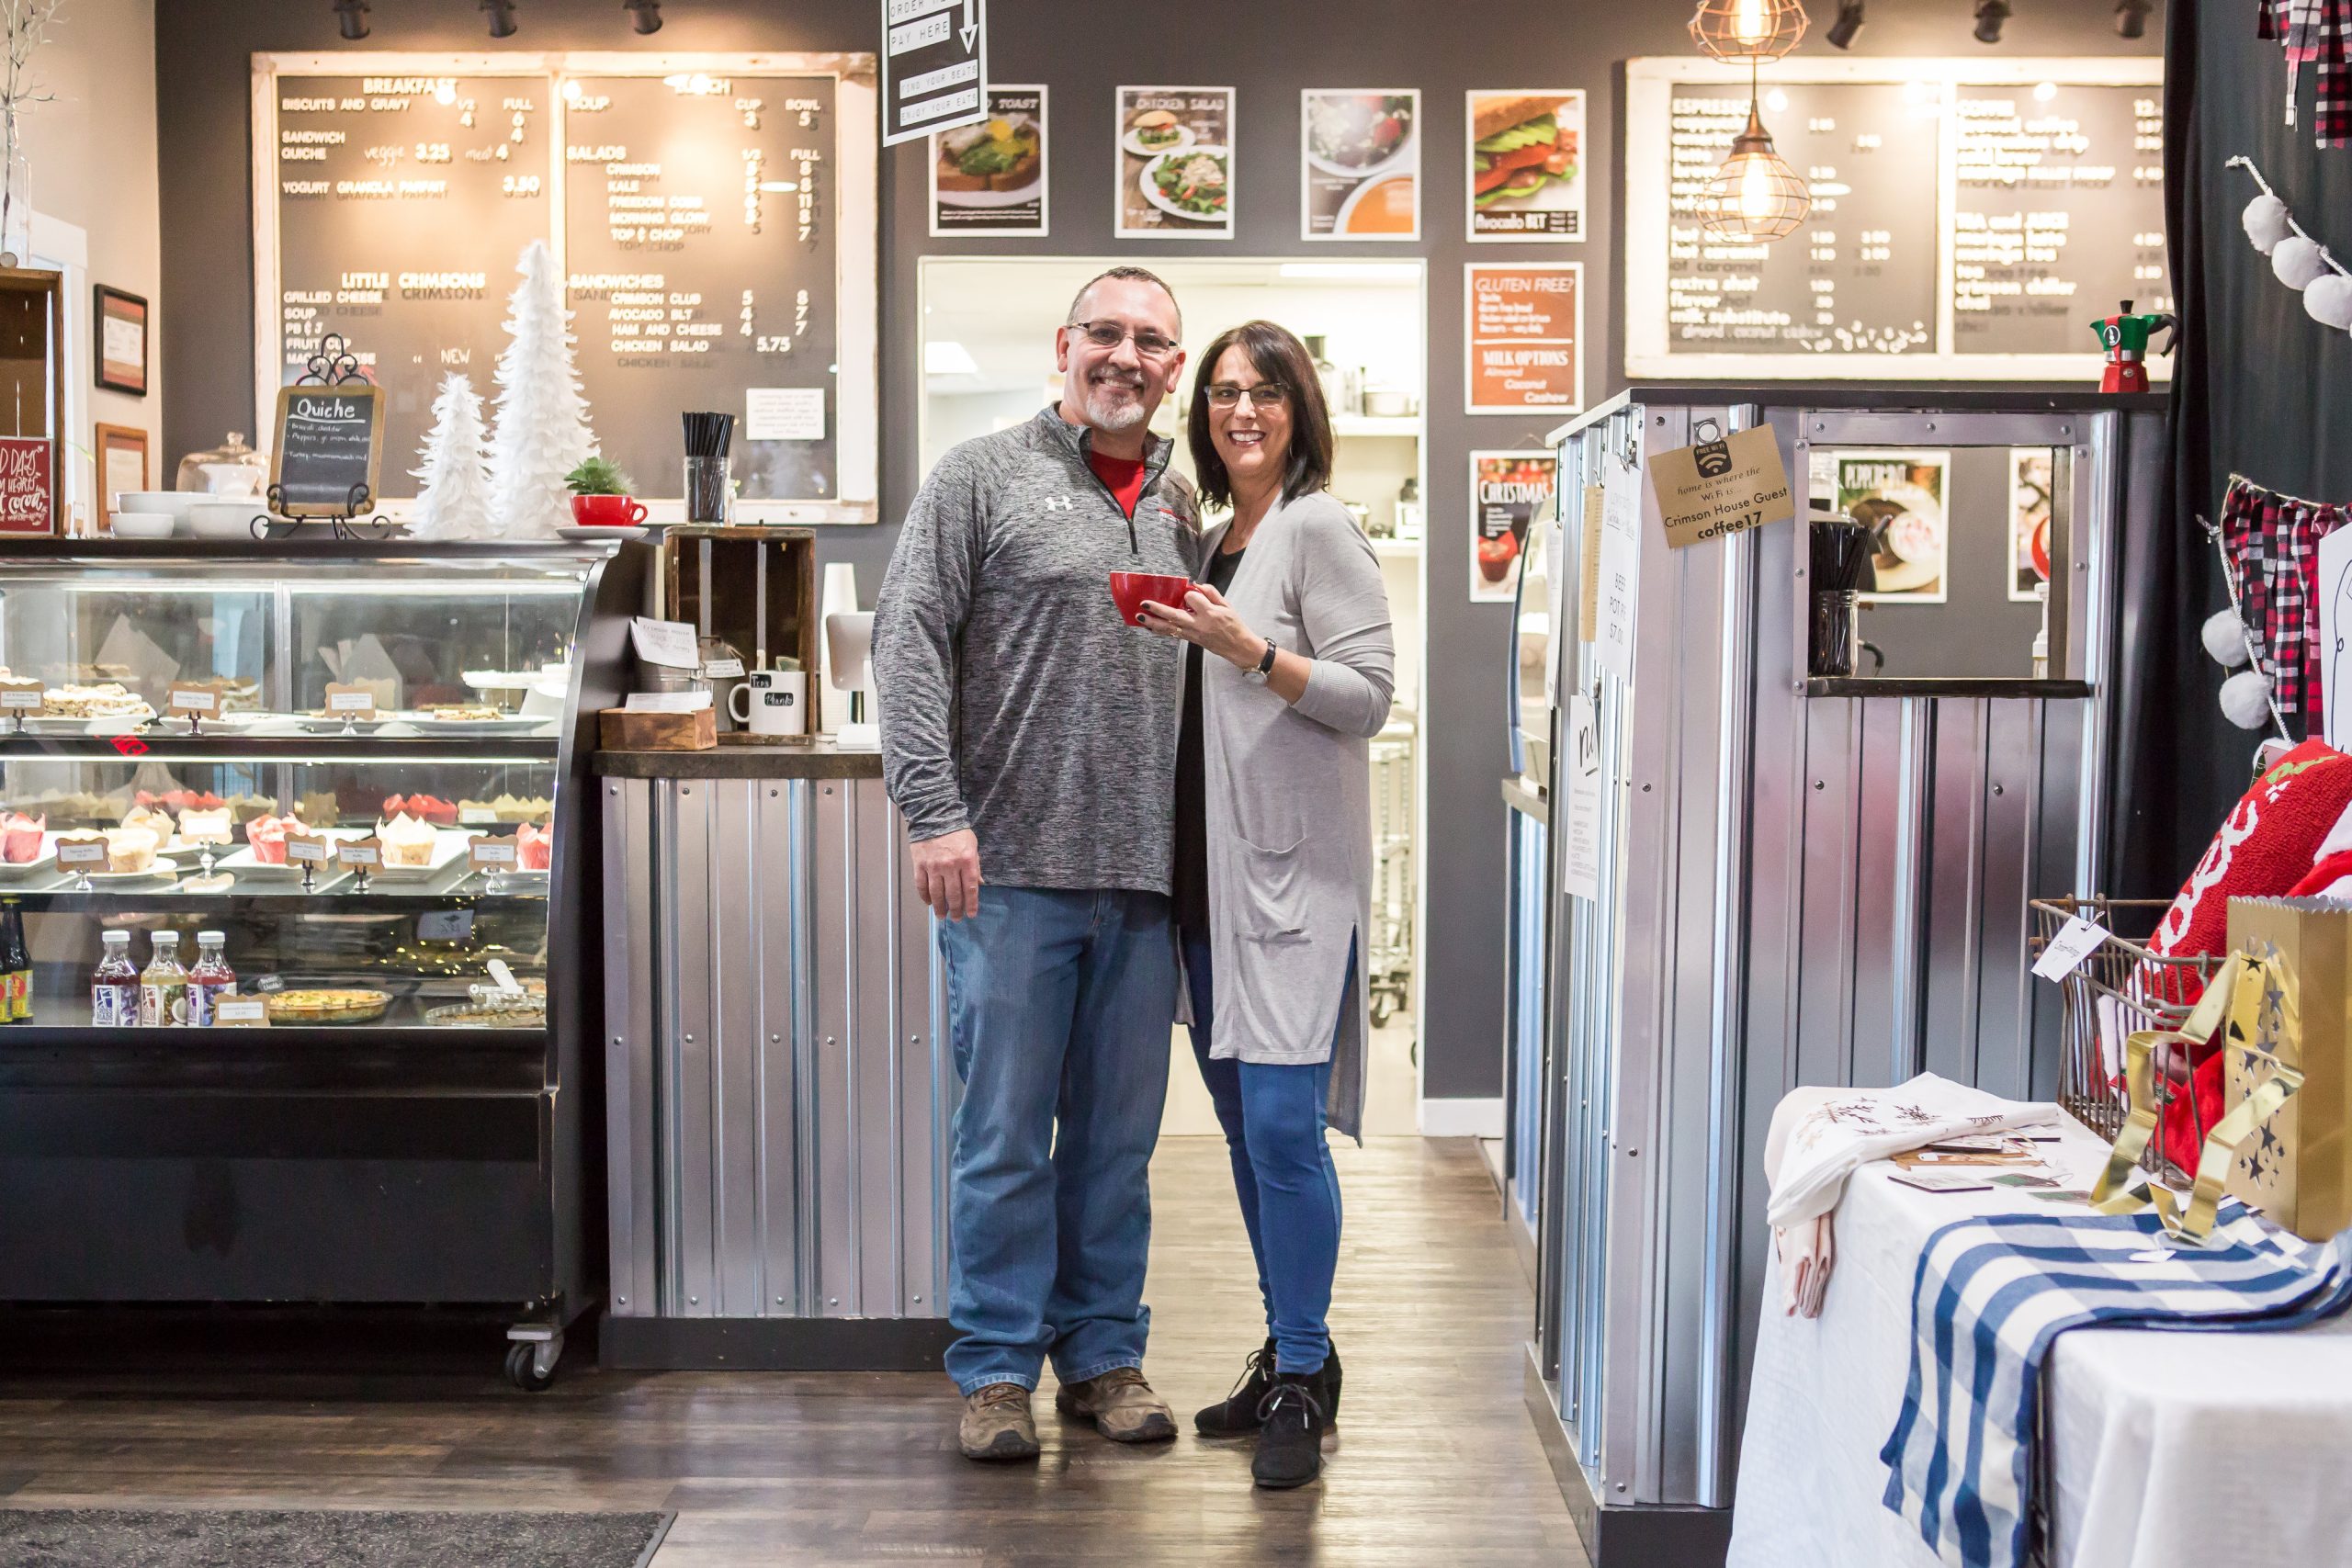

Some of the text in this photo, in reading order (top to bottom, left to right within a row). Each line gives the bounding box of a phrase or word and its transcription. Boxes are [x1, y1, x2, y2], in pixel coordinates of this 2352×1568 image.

[891, 20, 949, 47] PAY HERE
[363, 77, 458, 96] BREAKFAST
[282, 98, 336, 111] BISCUITS
[341, 98, 366, 111] AND
[370, 98, 411, 111] GRAVY
[503, 98, 533, 111] FULL
[568, 96, 820, 111] SOUP CUP BOWL
[999, 98, 1039, 109] TOAST
[459, 111, 525, 128] 4 6
[744, 111, 811, 127] 3 5
[282, 128, 524, 143] SANDWICH 4
[282, 147, 326, 161] QUICHE
[364, 146, 404, 166] veggie
[415, 143, 451, 161] 3.25
[496, 143, 509, 161] 4
[566, 145, 627, 161] SALADS
[790, 149, 820, 161] FULL
[606, 164, 661, 175] CRIMSON
[283, 182, 330, 194] YOGURT
[336, 181, 394, 194] GRANOLA
[399, 180, 447, 193] PARFAIT
[607, 180, 640, 193] KALE
[609, 196, 664, 209] FREEDOM
[609, 212, 665, 225] MORNING
[671, 212, 709, 225] GLORY
[611, 229, 635, 241] TOP
[650, 229, 684, 241] CHOP
[342, 273, 486, 289] LITTLE CRIMSONS
[569, 274, 664, 289] SANDWICHES
[1475, 277, 1532, 292] GLUTEN
[283, 291, 382, 304] GRILLED CHEESE
[610, 293, 664, 305] CRIMSON
[670, 293, 701, 305] CLUB
[742, 290, 753, 305] 5
[284, 308, 317, 320] SOUP
[608, 309, 664, 321] AVOCADO
[671, 309, 693, 321] BLT
[740, 306, 752, 321] 4
[286, 322, 302, 334] PB
[612, 324, 639, 336] HAM
[645, 324, 671, 336] AND
[676, 324, 722, 336] CHEESE
[740, 321, 752, 337] 4
[286, 337, 351, 350] FRUIT CUP
[611, 336, 791, 353] CHICKEN SALAD 5.75
[441, 348, 470, 365] NEW
[297, 398, 355, 419] Quiche
[1696, 446, 1710, 456] FREE
[1677, 467, 1761, 496] home is where the
[1479, 479, 1550, 505] CHRISTMAS
[1664, 486, 1788, 529] Crimson House Guest
[1697, 511, 1763, 540] coffee17
